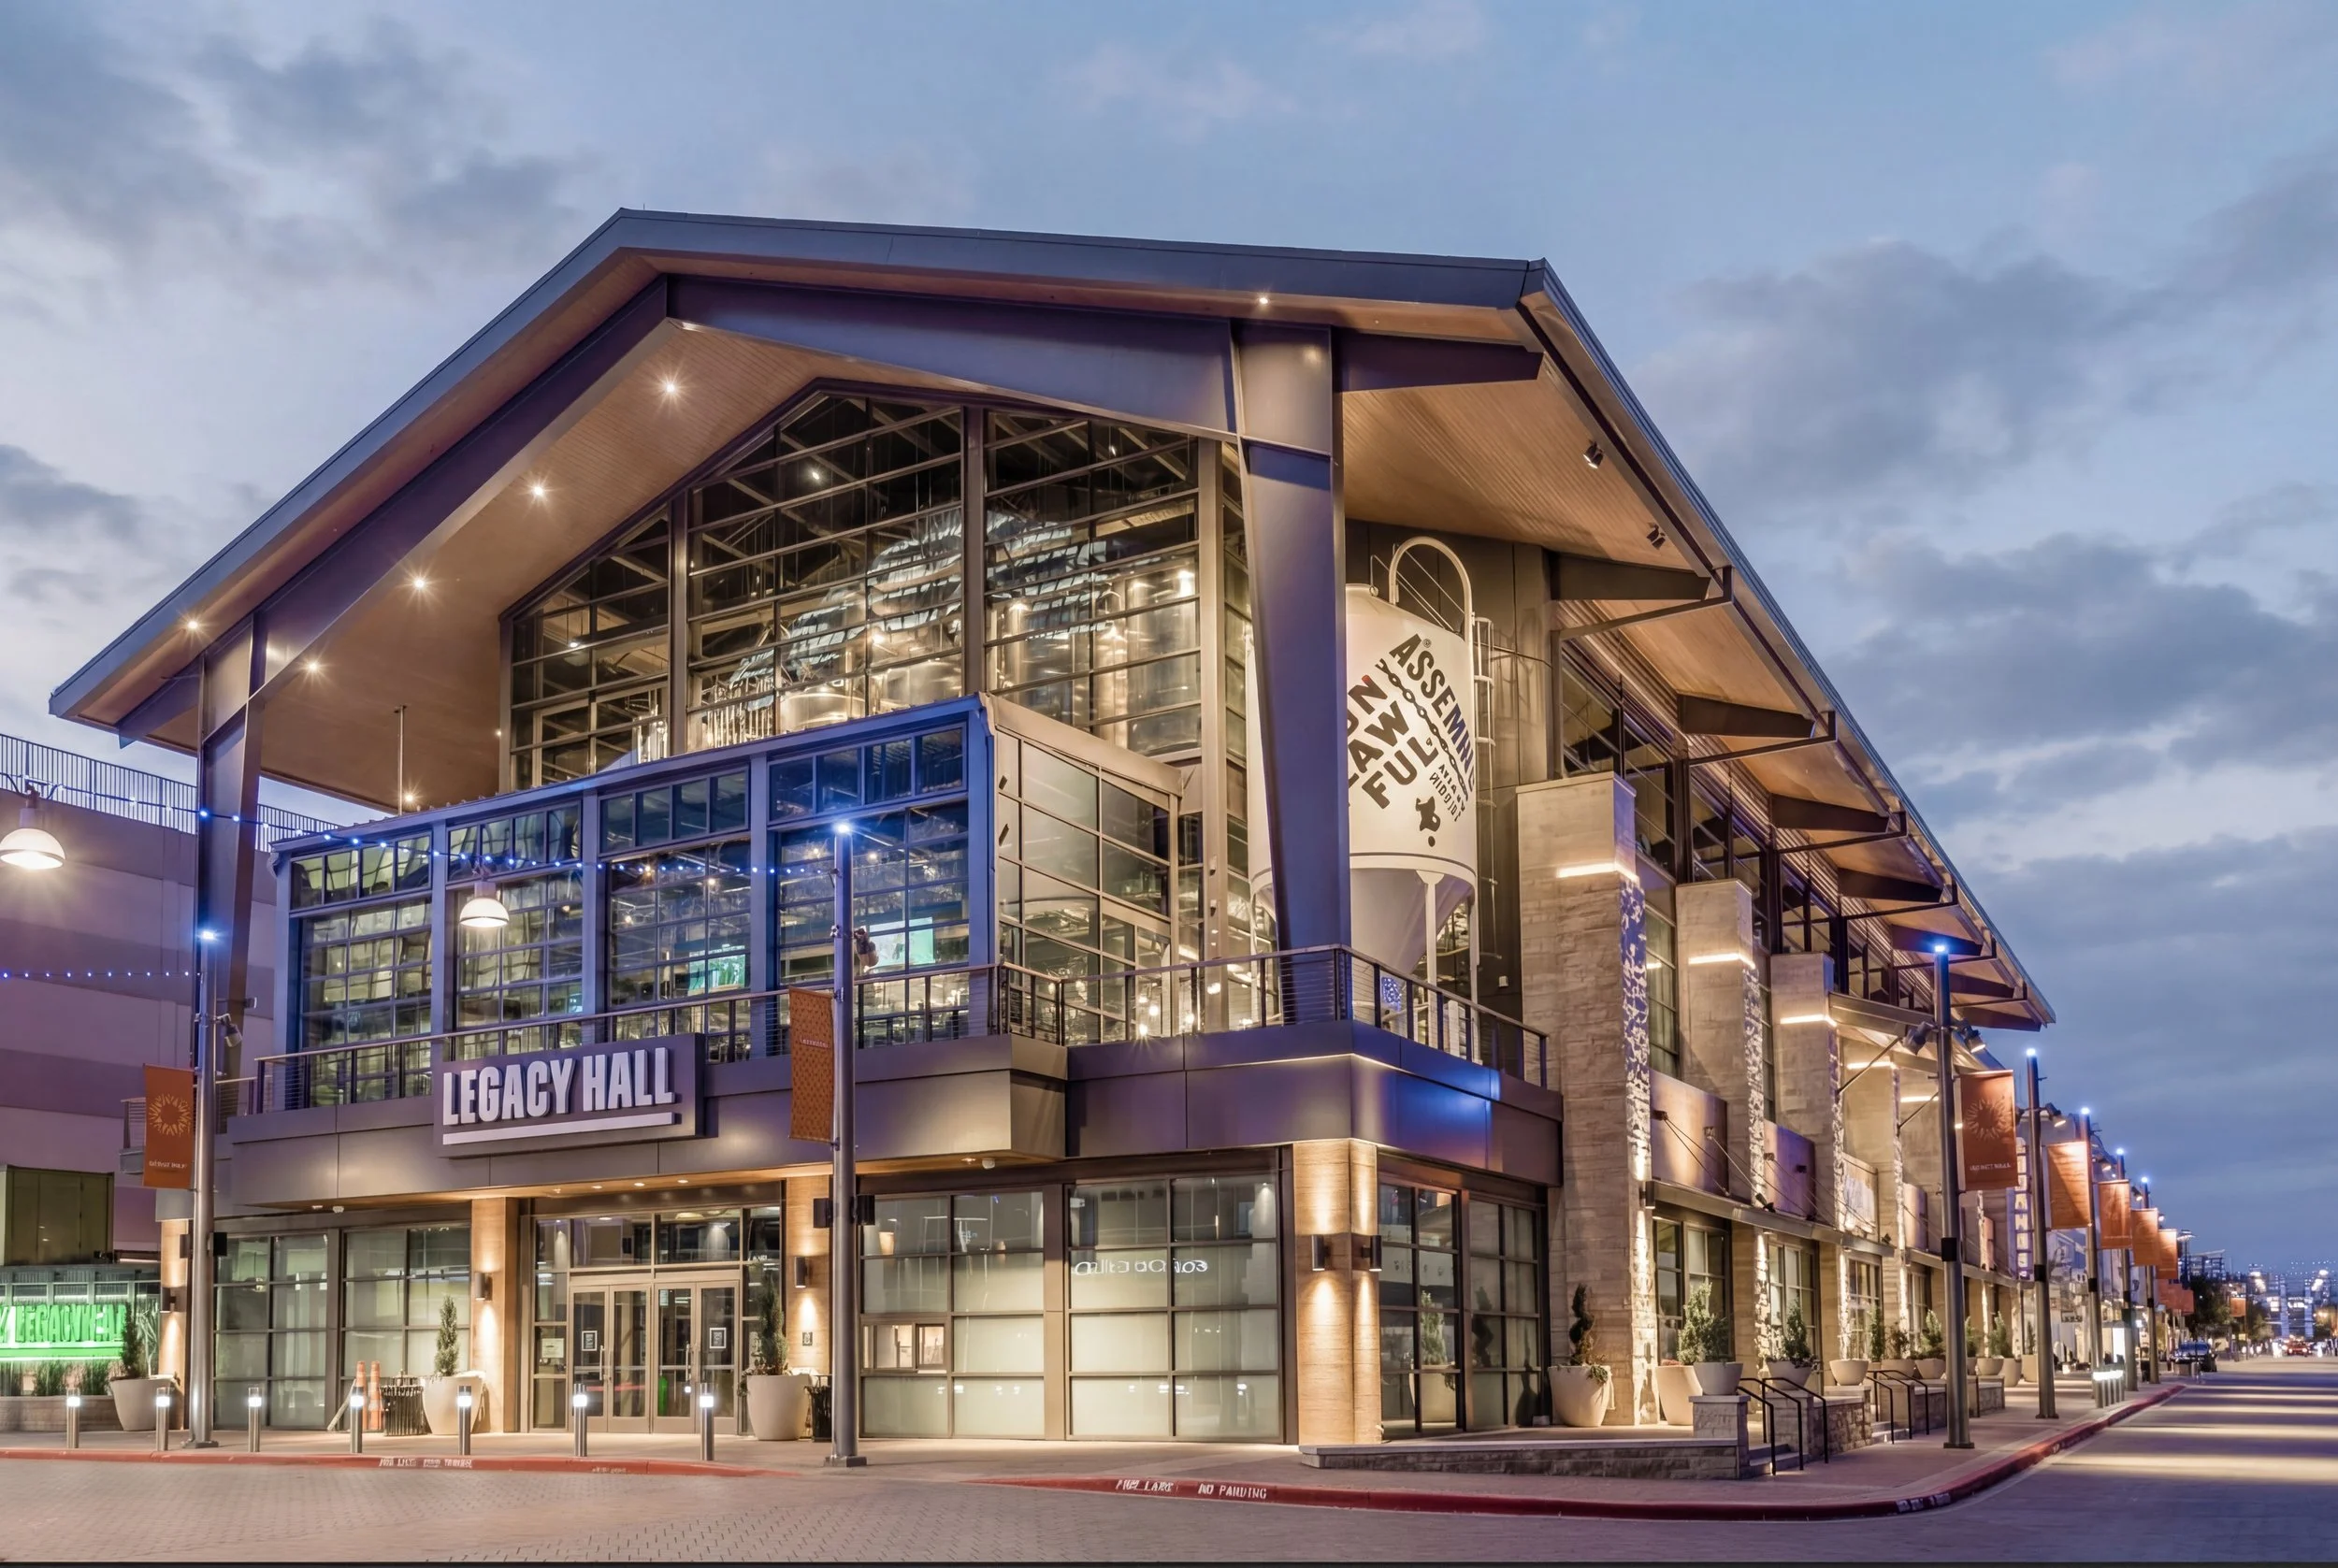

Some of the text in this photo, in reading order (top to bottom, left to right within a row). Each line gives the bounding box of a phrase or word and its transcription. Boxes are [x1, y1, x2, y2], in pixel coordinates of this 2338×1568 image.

[1349, 700, 1409, 788] AW
[1362, 737, 1439, 810] FUL
[442, 1046, 675, 1126] LEGACY HALL
[88, 1303, 127, 1343] HAL
